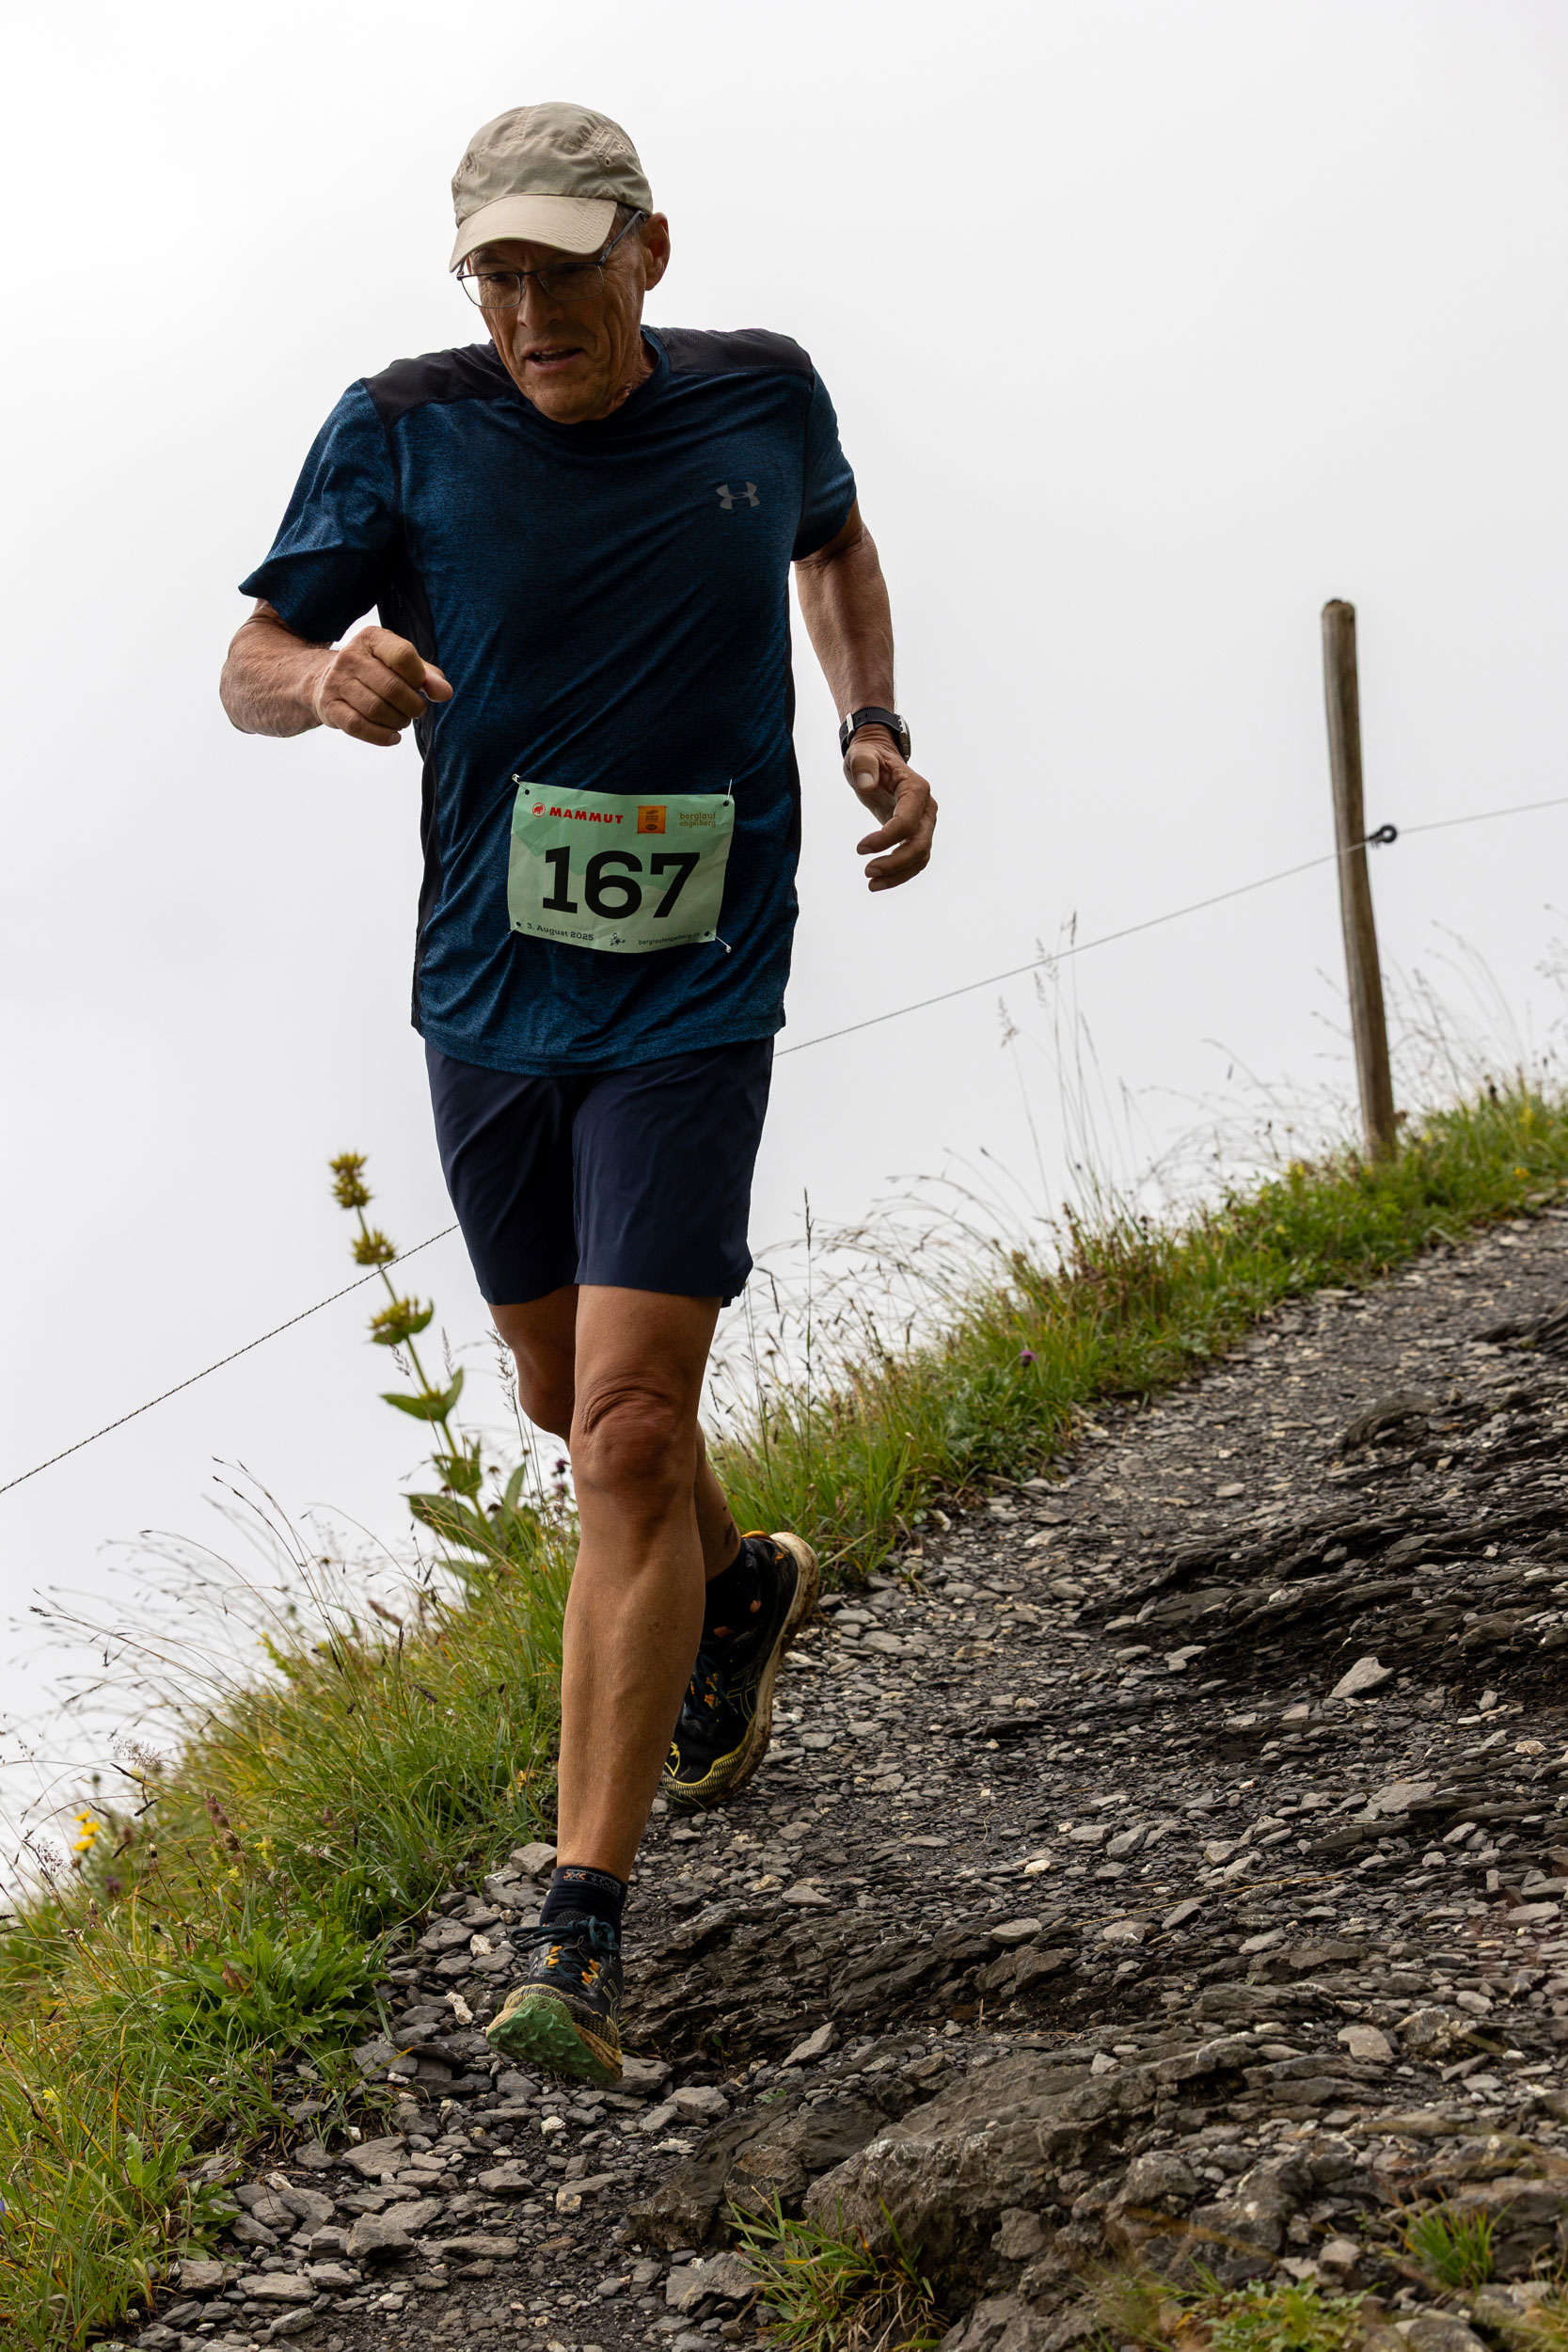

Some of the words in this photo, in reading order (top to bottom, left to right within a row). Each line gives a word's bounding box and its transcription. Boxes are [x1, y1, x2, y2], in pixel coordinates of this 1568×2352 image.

[549, 806, 624, 824] MAMMUT
[679, 812, 716, 820] berglauf
[542, 846, 701, 920] 167
[536, 925, 569, 936] August
[570, 930, 594, 941] 2025
